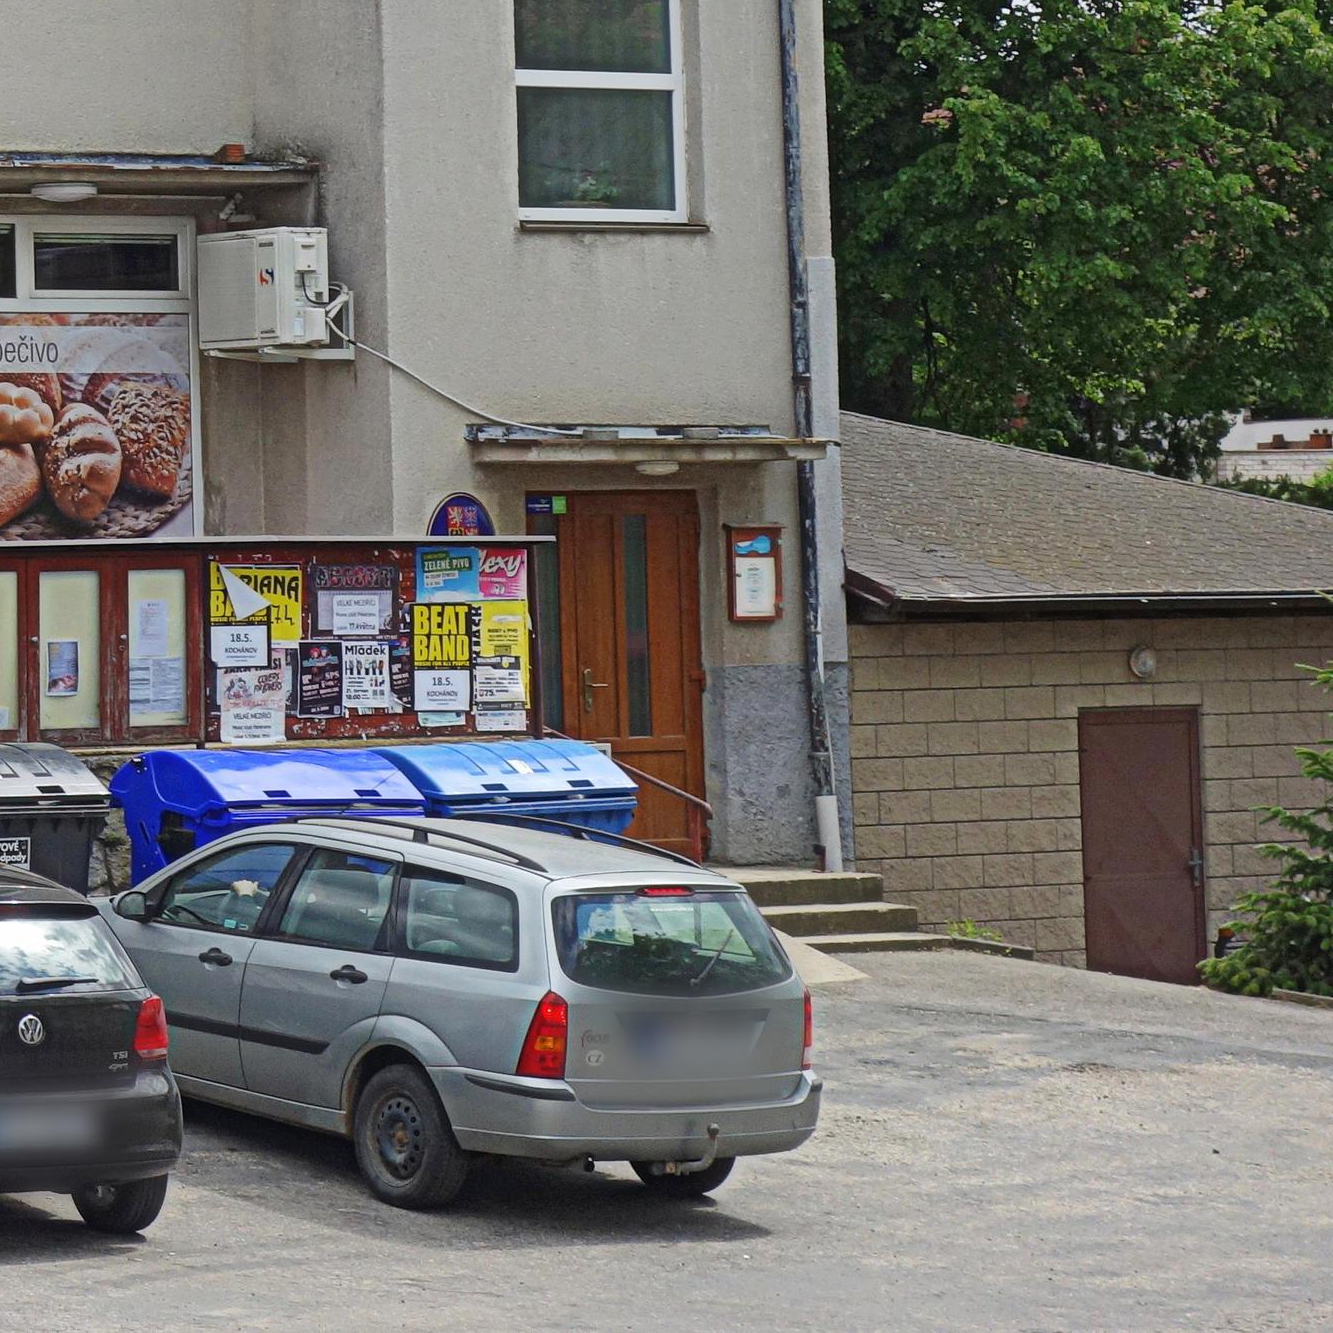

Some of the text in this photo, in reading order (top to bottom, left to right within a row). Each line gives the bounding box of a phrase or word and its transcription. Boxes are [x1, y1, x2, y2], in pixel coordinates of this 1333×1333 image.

[414, 605, 469, 635] BEAT
[230, 633, 253, 643] 18.5.
[344, 644, 387, 656] Mládek
[414, 634, 470, 661] BAND
[432, 677, 454, 686] 18.5.
